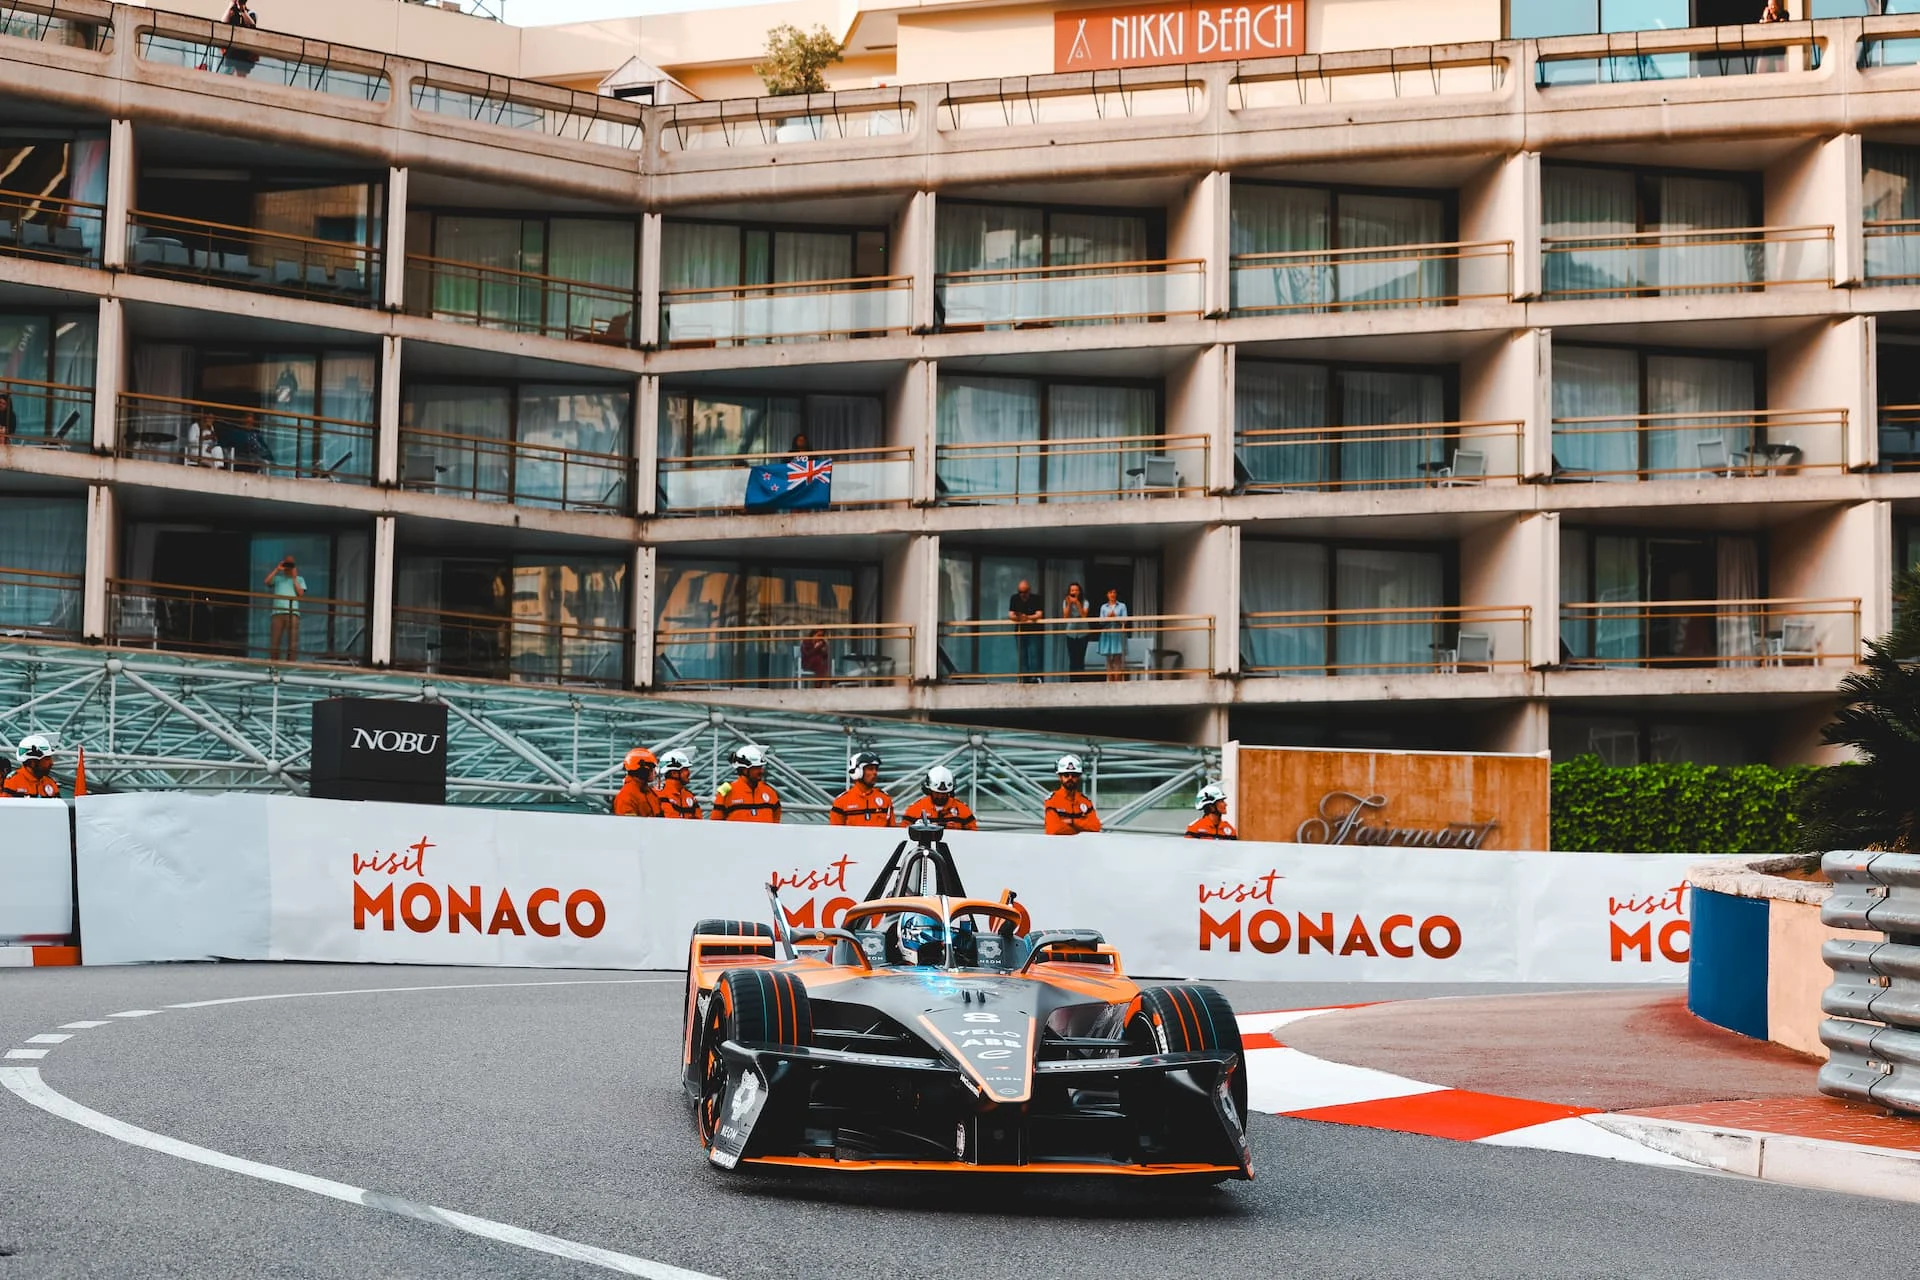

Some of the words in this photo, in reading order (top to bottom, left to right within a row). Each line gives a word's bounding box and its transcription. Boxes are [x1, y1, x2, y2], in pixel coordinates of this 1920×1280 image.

[1112, 12, 1184, 60] NIKKI
[1198, 4, 1292, 54] BEACH
[350, 727, 440, 755] NOBU
[1296, 791, 1501, 850] Fairmont
[352, 835, 437, 877] visit
[771, 854, 858, 892] visit
[1199, 868, 1287, 905] visit
[1608, 879, 1691, 916] visit
[353, 880, 606, 939] MONACO
[1199, 907, 1462, 960] MONACO
